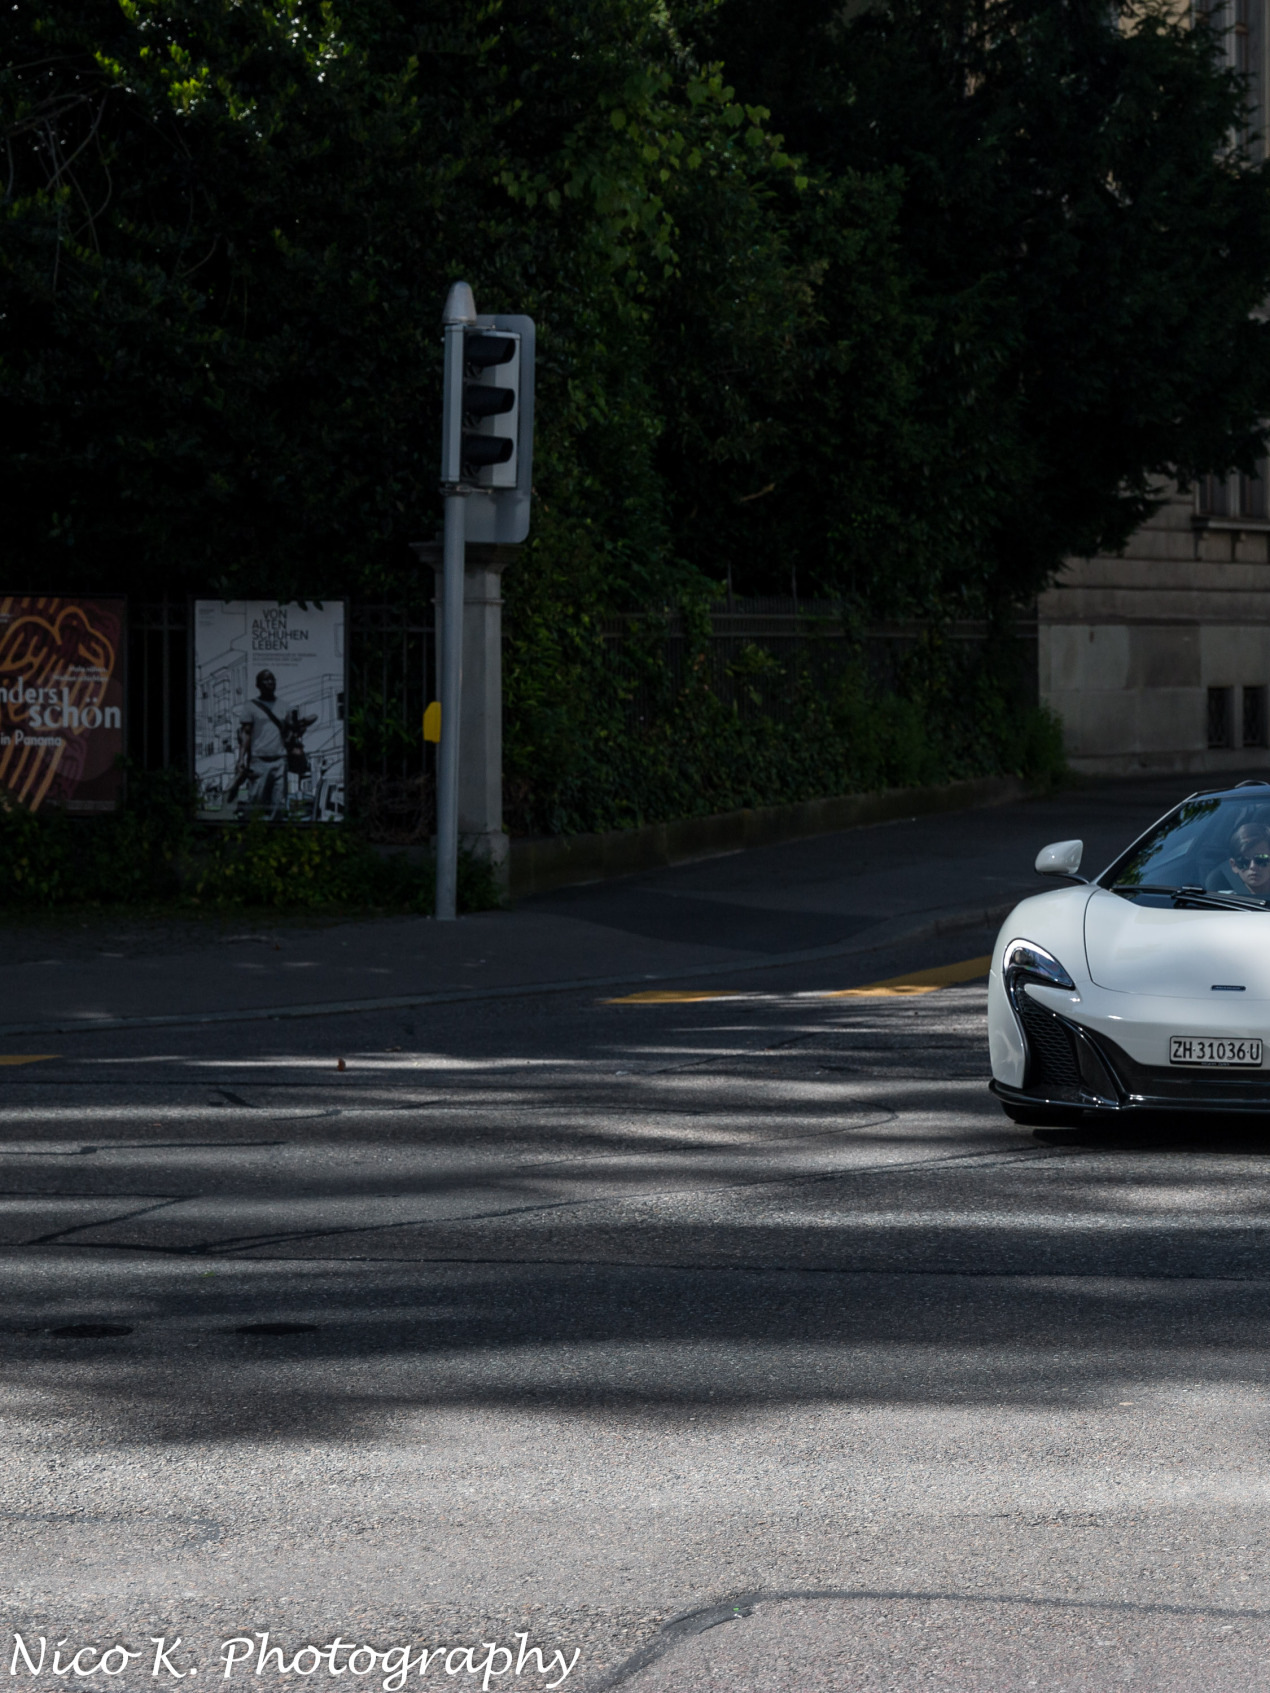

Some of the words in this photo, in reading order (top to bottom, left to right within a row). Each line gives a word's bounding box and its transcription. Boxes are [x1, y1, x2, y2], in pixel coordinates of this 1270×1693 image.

[262, 609, 287, 620] VON
[252, 619, 287, 629] ALTEN
[252, 630, 309, 640] SCHUHEN
[252, 640, 288, 650] LEBEN
[28, 687, 121, 729] schön
[15, 729, 62, 746] Panama
